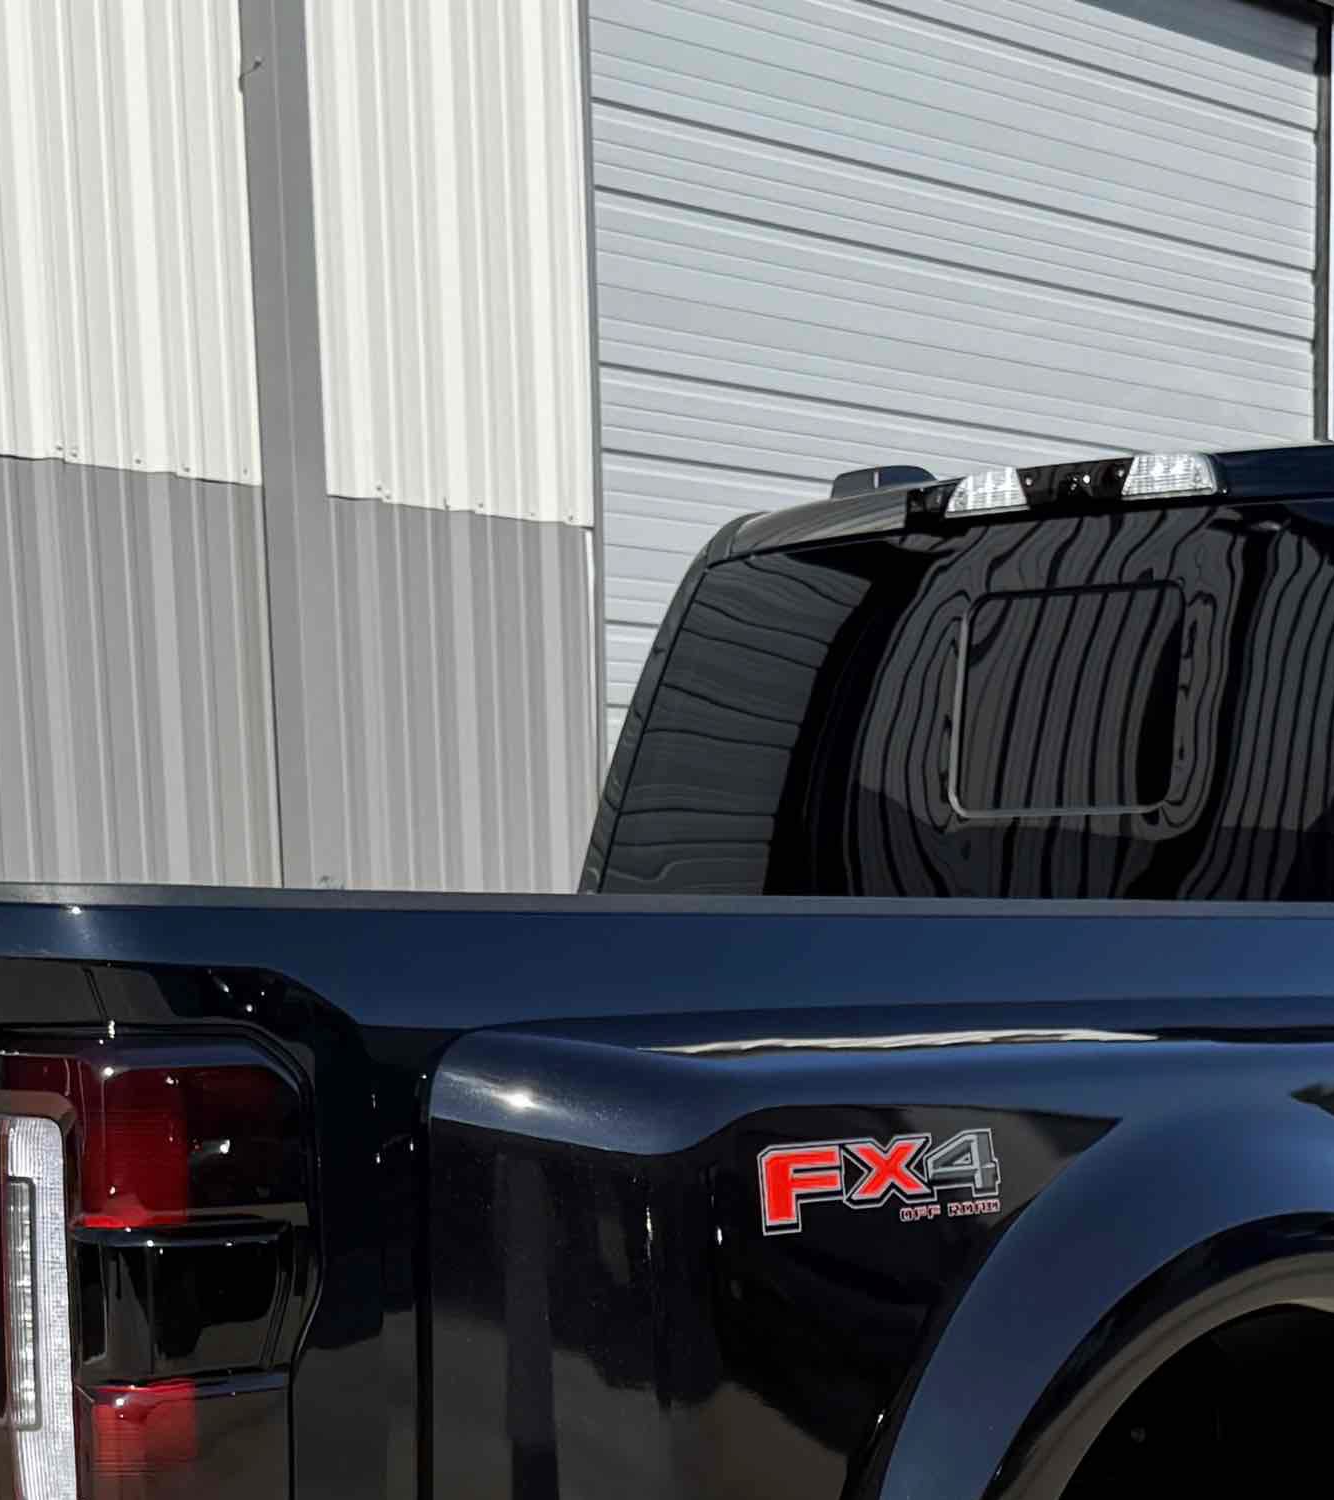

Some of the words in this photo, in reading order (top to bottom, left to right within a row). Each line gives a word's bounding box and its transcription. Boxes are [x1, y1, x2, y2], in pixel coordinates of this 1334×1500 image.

[757, 1128, 1001, 1236] FX4
[899, 1204, 941, 1222] OFF
[947, 1199, 1001, 1218] ROAD
